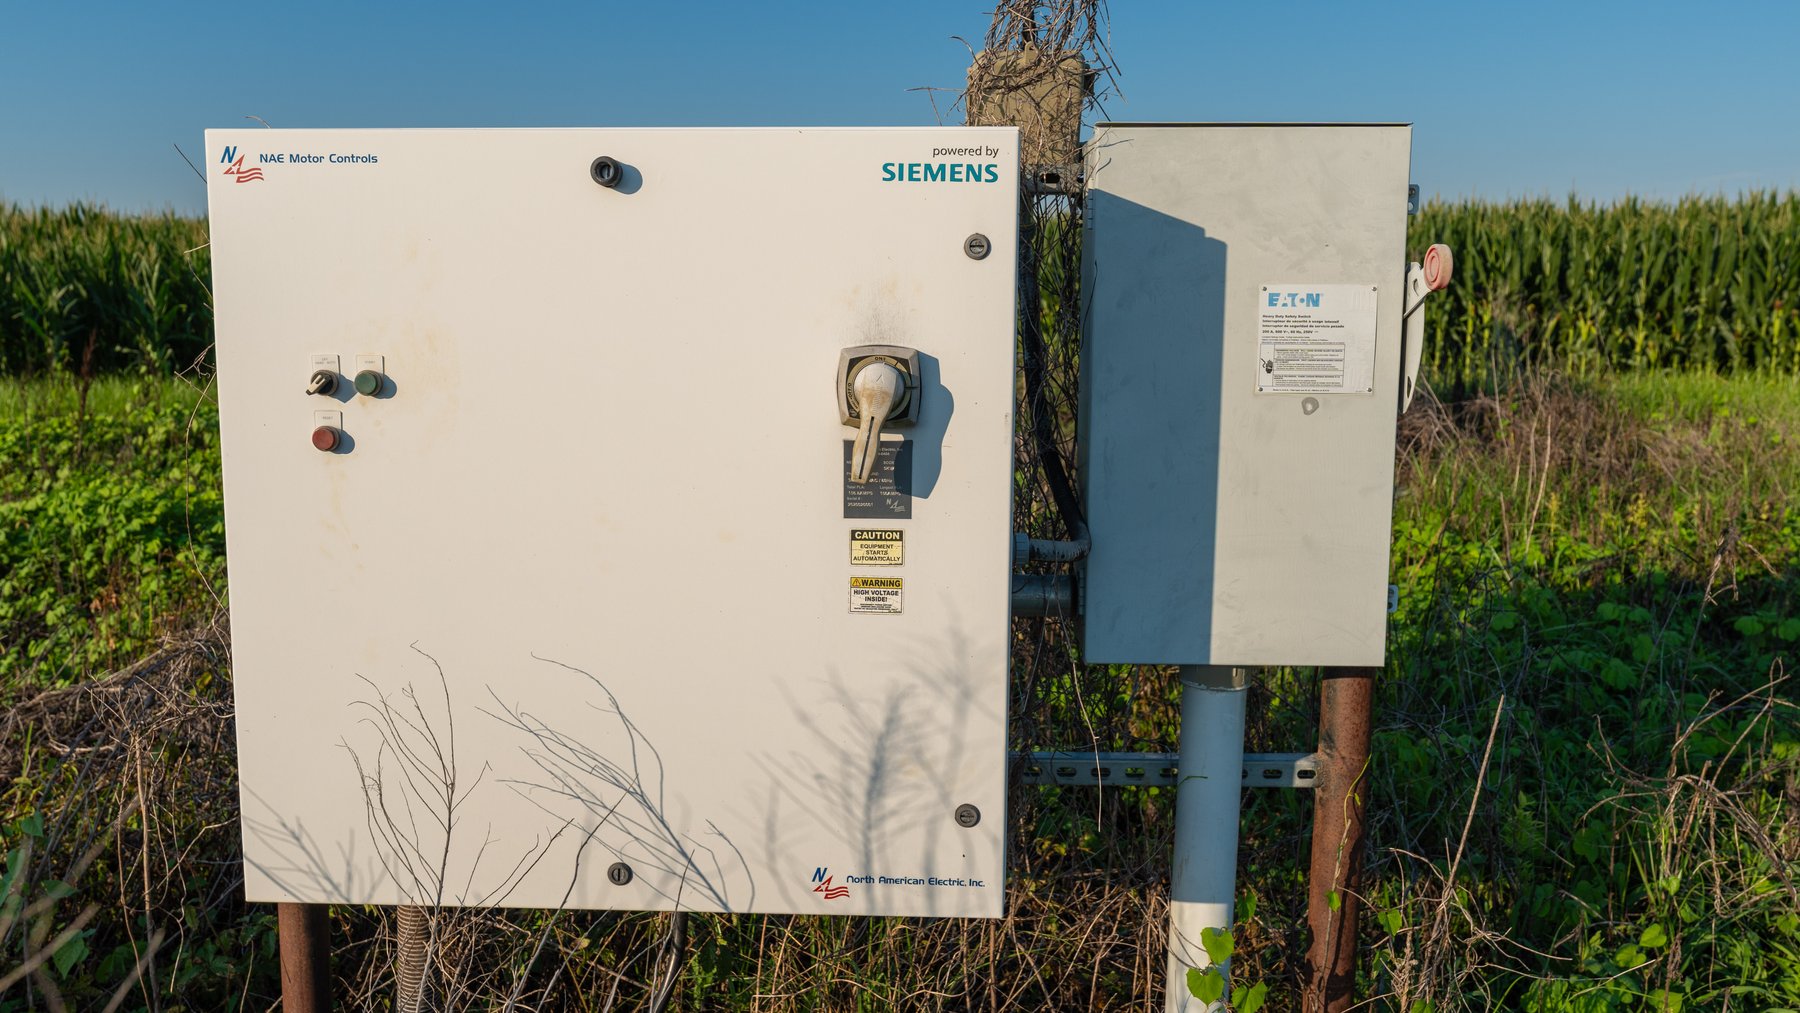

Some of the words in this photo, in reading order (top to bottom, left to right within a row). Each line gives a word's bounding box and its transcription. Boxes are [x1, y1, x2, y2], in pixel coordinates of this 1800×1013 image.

[932, 146, 982, 158] powered
[985, 145, 999, 158] by
[259, 153, 284, 163] NAE
[289, 153, 325, 163] Motor
[329, 153, 378, 163] Controls
[881, 162, 999, 183] SIEMENS
[1268, 292, 1321, 307] EATON
[854, 532, 900, 540] CAUTION
[861, 579, 901, 587] WARNING
[846, 875, 874, 884] North
[878, 876, 924, 885] American
[969, 878, 986, 887] Inc.
